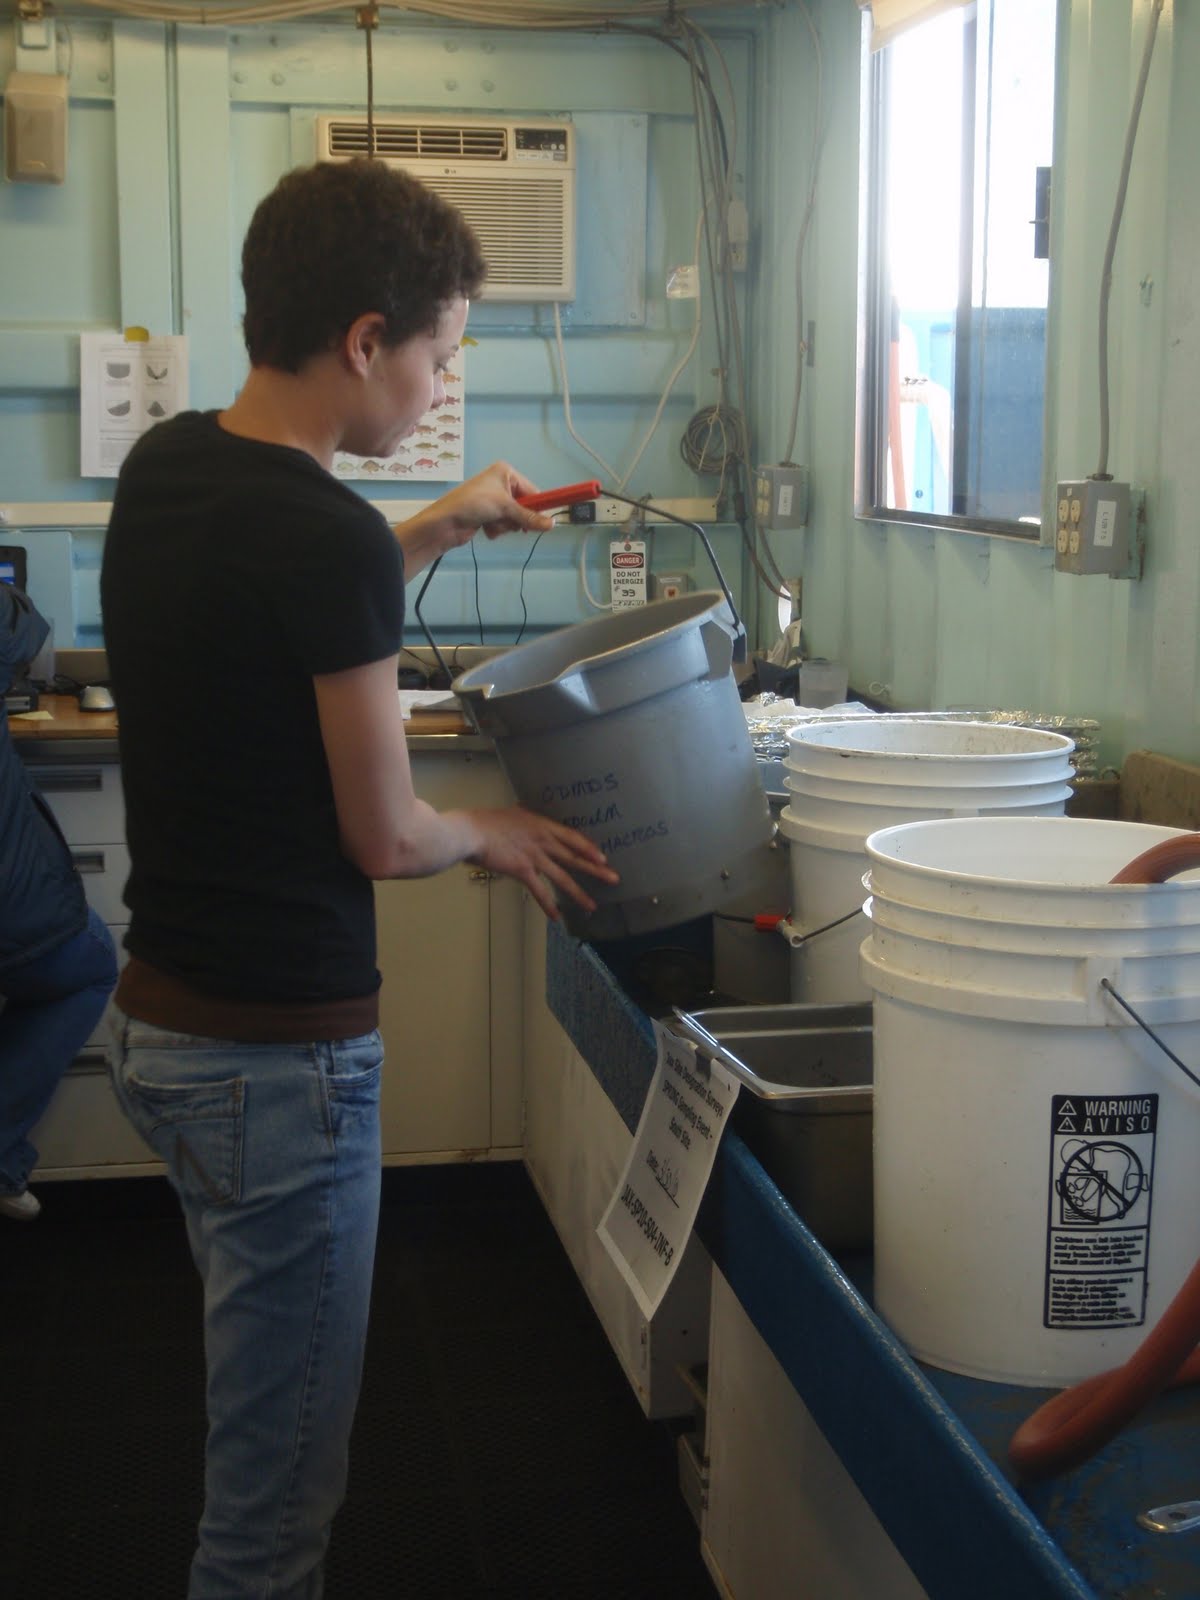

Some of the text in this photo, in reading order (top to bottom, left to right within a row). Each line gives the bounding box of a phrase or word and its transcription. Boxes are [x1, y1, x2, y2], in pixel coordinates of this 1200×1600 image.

[682, 1067, 707, 1098] Designation
[706, 1091, 724, 1118] Surveys
[1085, 1099, 1151, 1116] WARNING
[678, 1096, 697, 1128] Sampling
